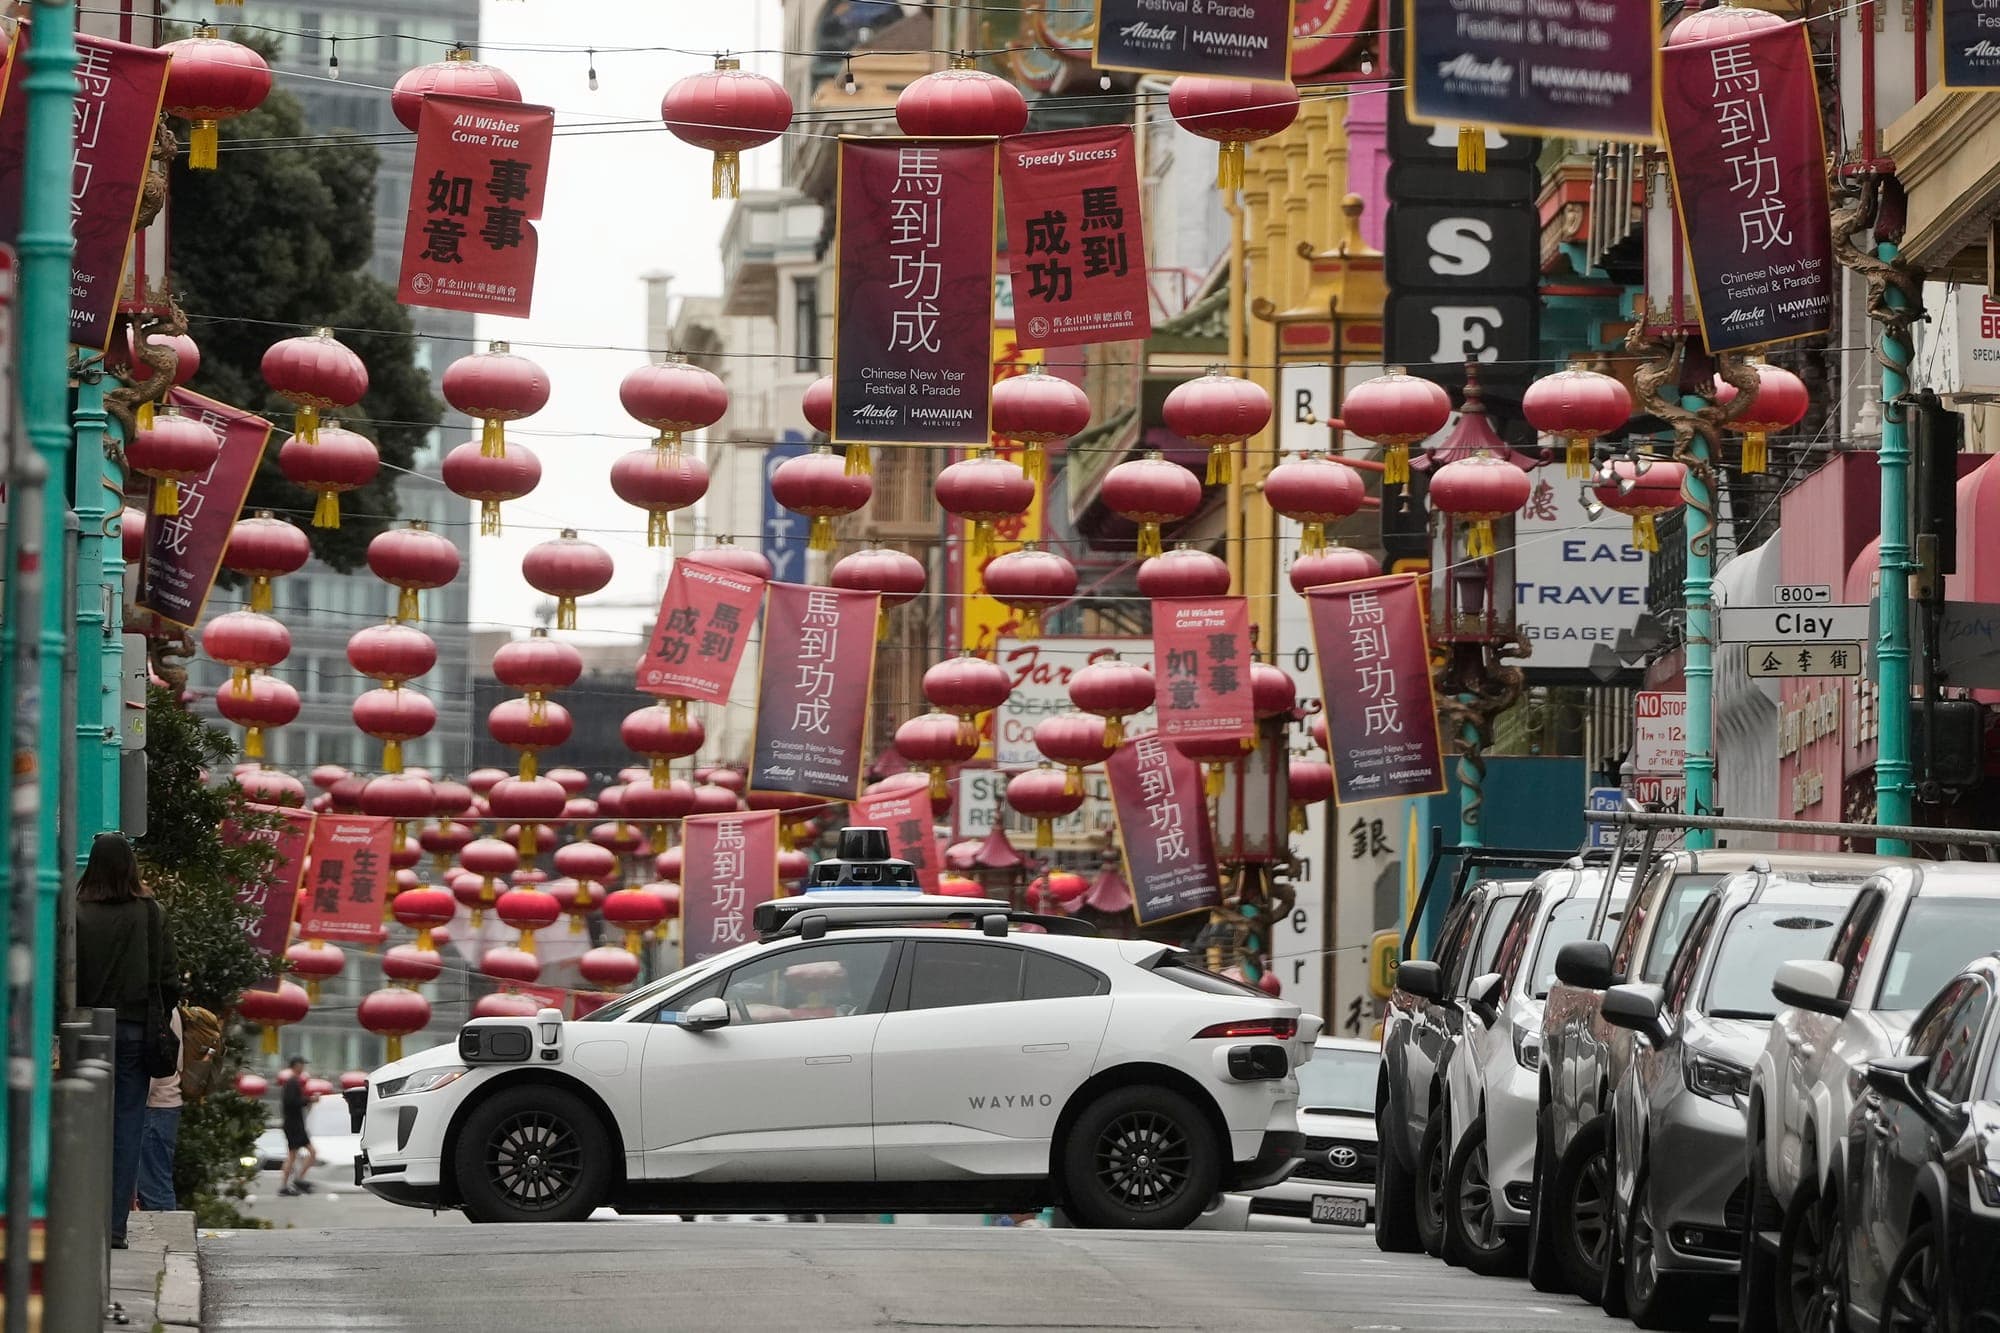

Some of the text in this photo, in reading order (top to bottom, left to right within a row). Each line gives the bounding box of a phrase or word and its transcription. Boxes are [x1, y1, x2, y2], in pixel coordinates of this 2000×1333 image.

[1137, 0, 1255, 19] Festival & Parade
[1120, 22, 1176, 41] Alaska
[1193, 30, 1268, 49] HAWAIIAN
[1123, 39, 1171, 50] AIRLINES
[1206, 47, 1253, 57] AIRLINES
[454, 114, 520, 132] All Wishes
[451, 130, 519, 149] Come True
[1710, 43, 1792, 254] 馬到功成
[1018, 147, 1117, 168] Speedy Success
[479, 158, 532, 251] 事事
[419, 169, 473, 264] 如意
[1079, 186, 1128, 279] 馬到
[887, 147, 942, 354] 馬到功成
[1025, 210, 1073, 303] 成功
[1720, 258, 1822, 285] Chinese New Year
[1728, 273, 1821, 300] Festival & Parade
[1720, 306, 1766, 325] Alaska
[1726, 320, 1764, 332] AIRLINES
[861, 367, 965, 380] Chinese New Year
[865, 383, 961, 396] Festival & Parade
[852, 403, 898, 418] Alaska
[911, 408, 973, 419] HAWAIIAN
[1781, 588, 1813, 601] 800
[1776, 613, 1833, 638] Clay
[790, 591, 840, 735] 馬到功成
[1006, 646, 1073, 689] Far
[1348, 590, 1403, 737] 馬到功成
[1761, 649, 1848, 673] 企李街
[1639, 695, 1686, 716] NO STOP
[1134, 737, 1189, 864] 馬到功成
[711, 819, 746, 943] 馬到功成
[969, 1093, 1053, 1110] WAYMO
